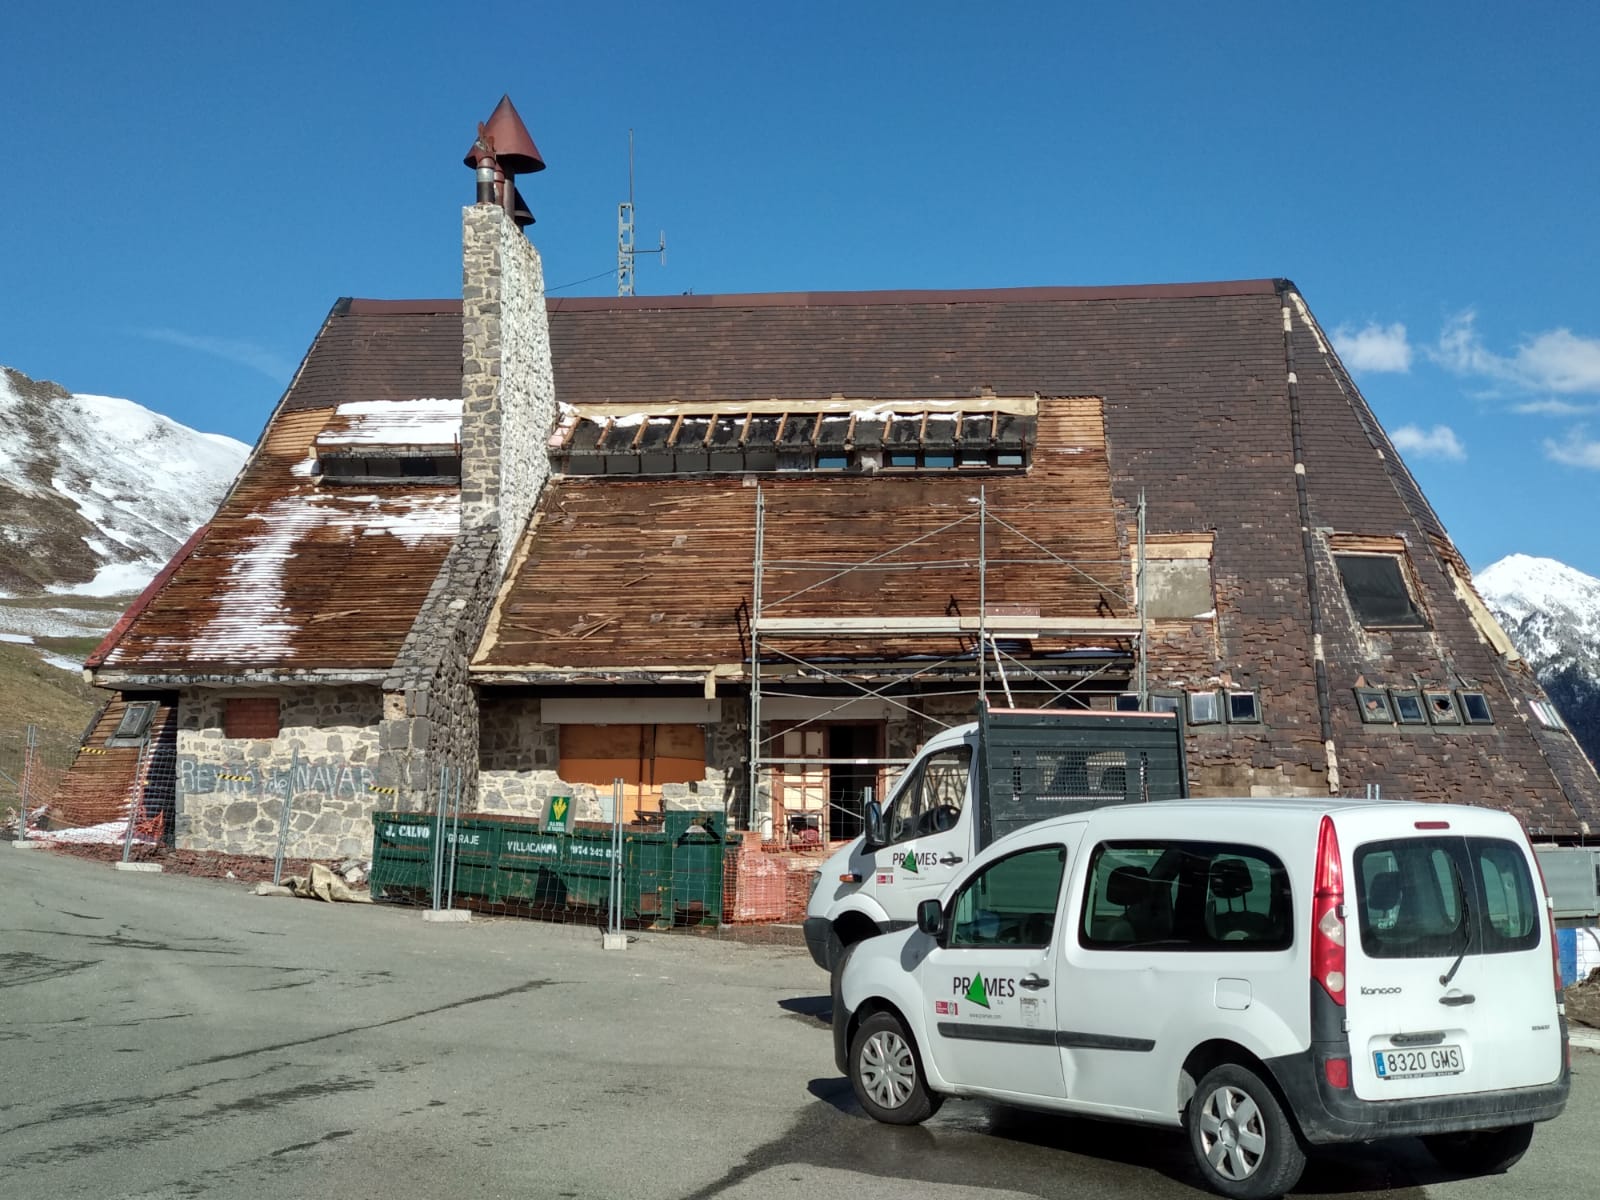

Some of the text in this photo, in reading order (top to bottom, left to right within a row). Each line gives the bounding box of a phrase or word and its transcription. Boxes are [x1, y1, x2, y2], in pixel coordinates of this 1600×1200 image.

[399, 825, 430, 839] CALVO
[507, 841, 557, 854] VILLACAMPA
[892, 849, 938, 869] PRAMES
[953, 972, 1015, 1003] PRAMES
[1360, 985, 1402, 996] Kangoo
[1387, 1050, 1459, 1072] 8320 GMS
